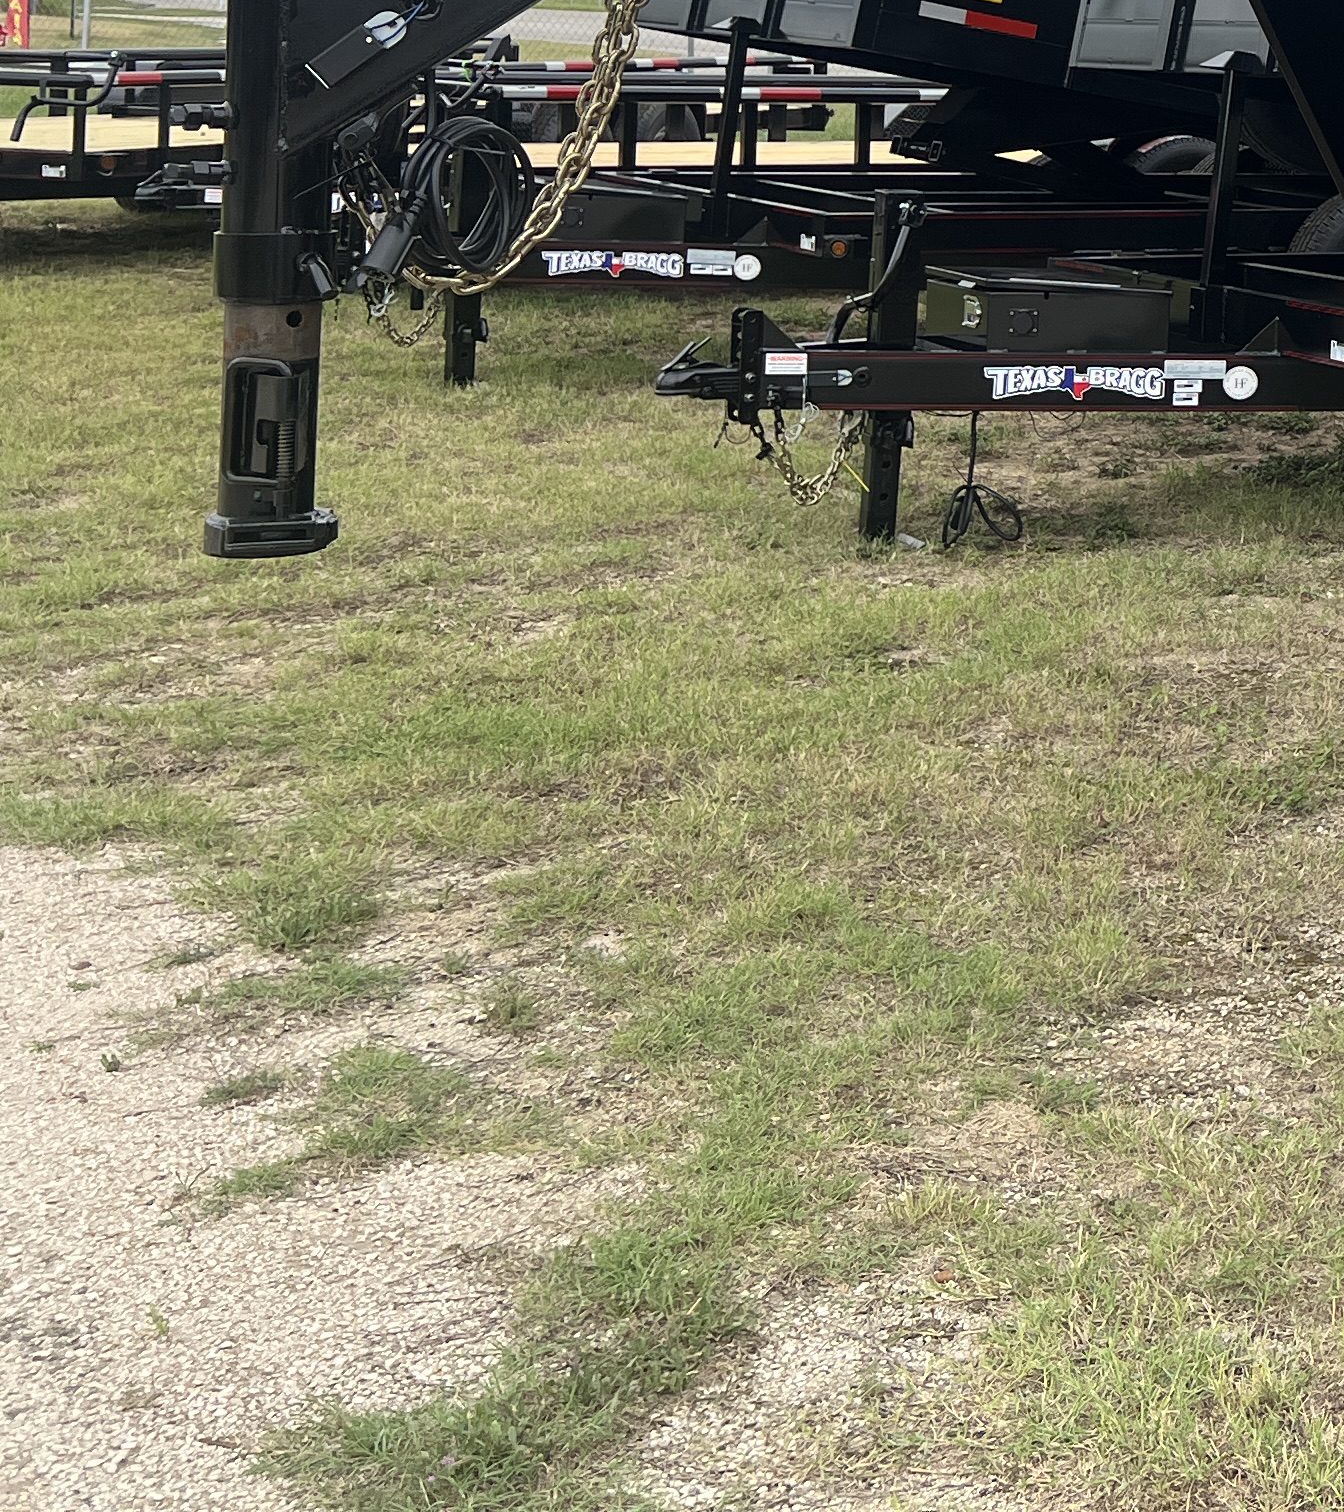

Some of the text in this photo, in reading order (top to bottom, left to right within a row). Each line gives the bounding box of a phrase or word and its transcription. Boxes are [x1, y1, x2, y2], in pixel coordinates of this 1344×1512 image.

[545, 251, 604, 275] TEXAS
[623, 252, 683, 276] BRAGG
[987, 367, 1062, 397] TEXAS
[1089, 367, 1164, 397] BRAGG
